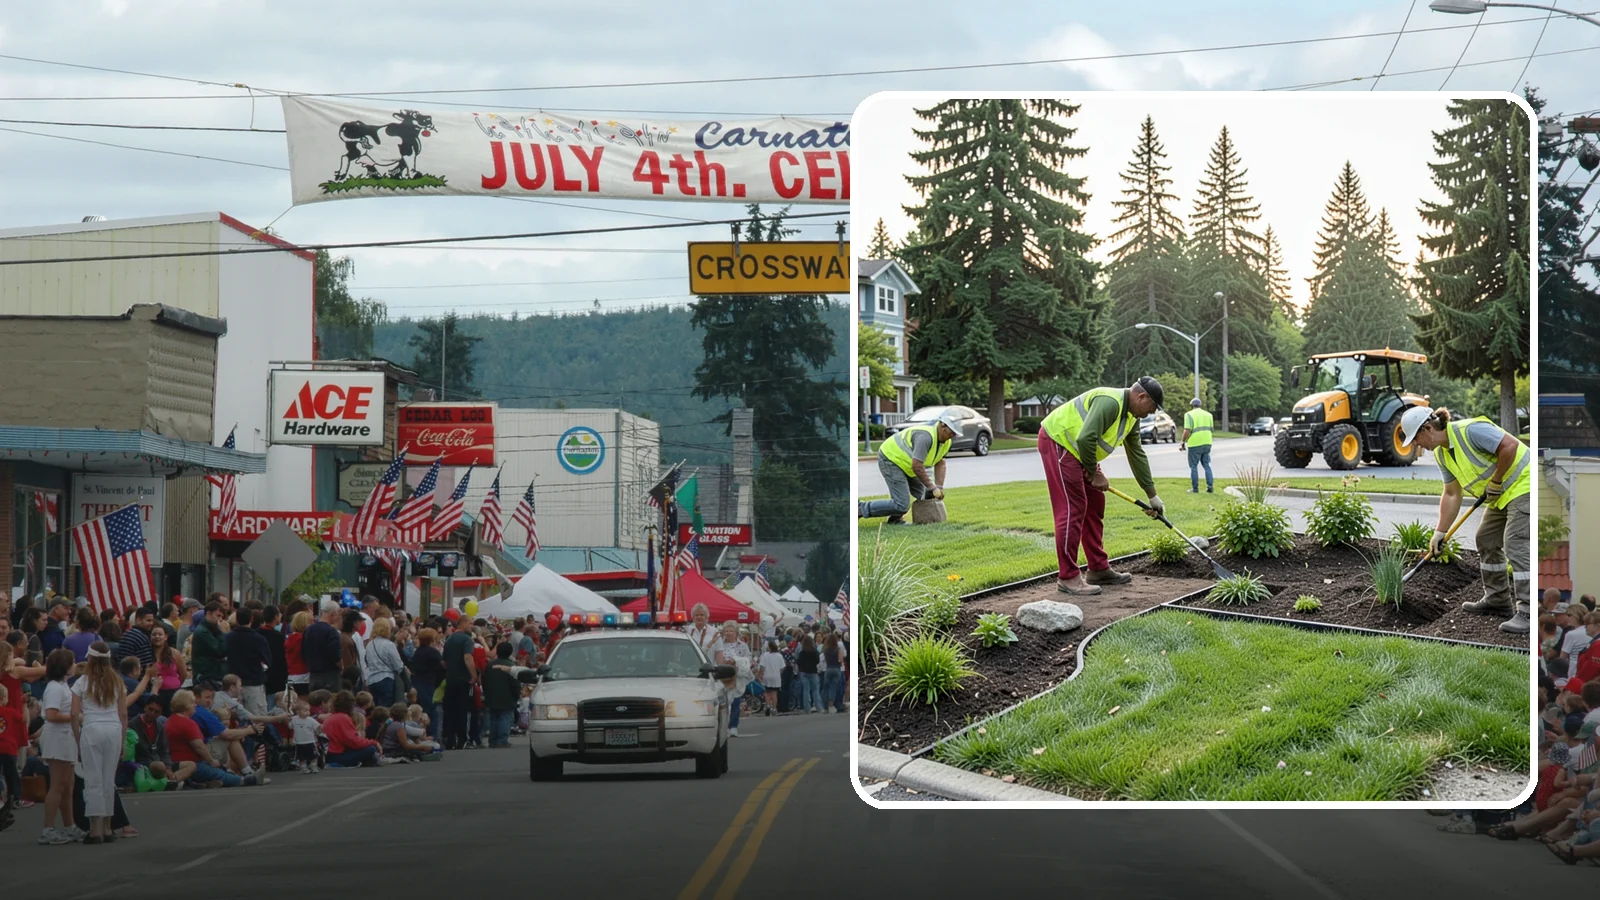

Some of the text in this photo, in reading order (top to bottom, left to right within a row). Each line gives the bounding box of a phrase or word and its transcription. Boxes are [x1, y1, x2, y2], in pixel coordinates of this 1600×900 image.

[695, 121, 850, 150] Carnat
[481, 141, 605, 192] JULY
[632, 150, 746, 197] 4th.
[697, 254, 850, 280] CROSSWA
[282, 380, 373, 420] ACE
[406, 410, 452, 421] CEDAR
[283, 421, 370, 436] Hardware
[416, 428, 476, 447] Coca-Cola
[353, 467, 385, 481] Simpl
[83, 485, 155, 495] St. Vincent de Paul
[212, 516, 331, 535] HARDARE
[688, 526, 741, 534] CRNATION
[699, 535, 730, 543] GLASS
